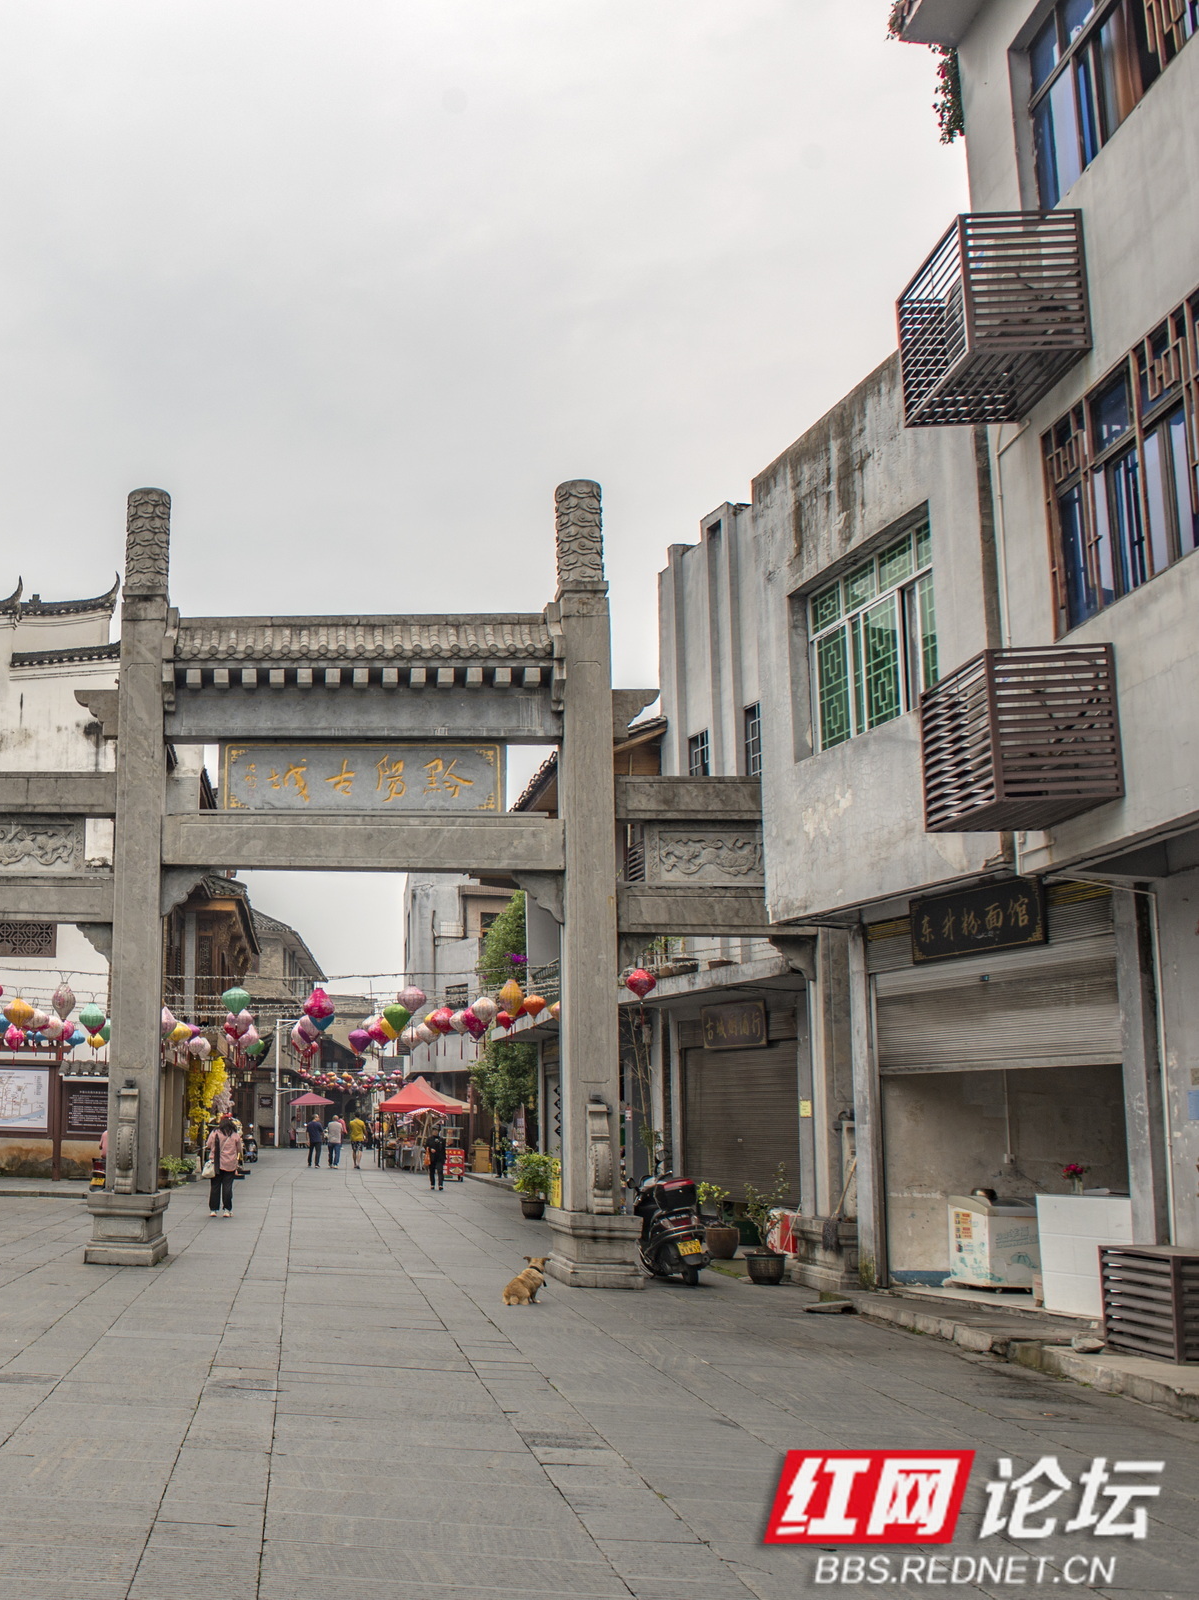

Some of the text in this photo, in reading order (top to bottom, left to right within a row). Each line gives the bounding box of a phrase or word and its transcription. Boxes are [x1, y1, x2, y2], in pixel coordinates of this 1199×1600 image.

[921, 895, 1030, 943] 东升粉面馆
